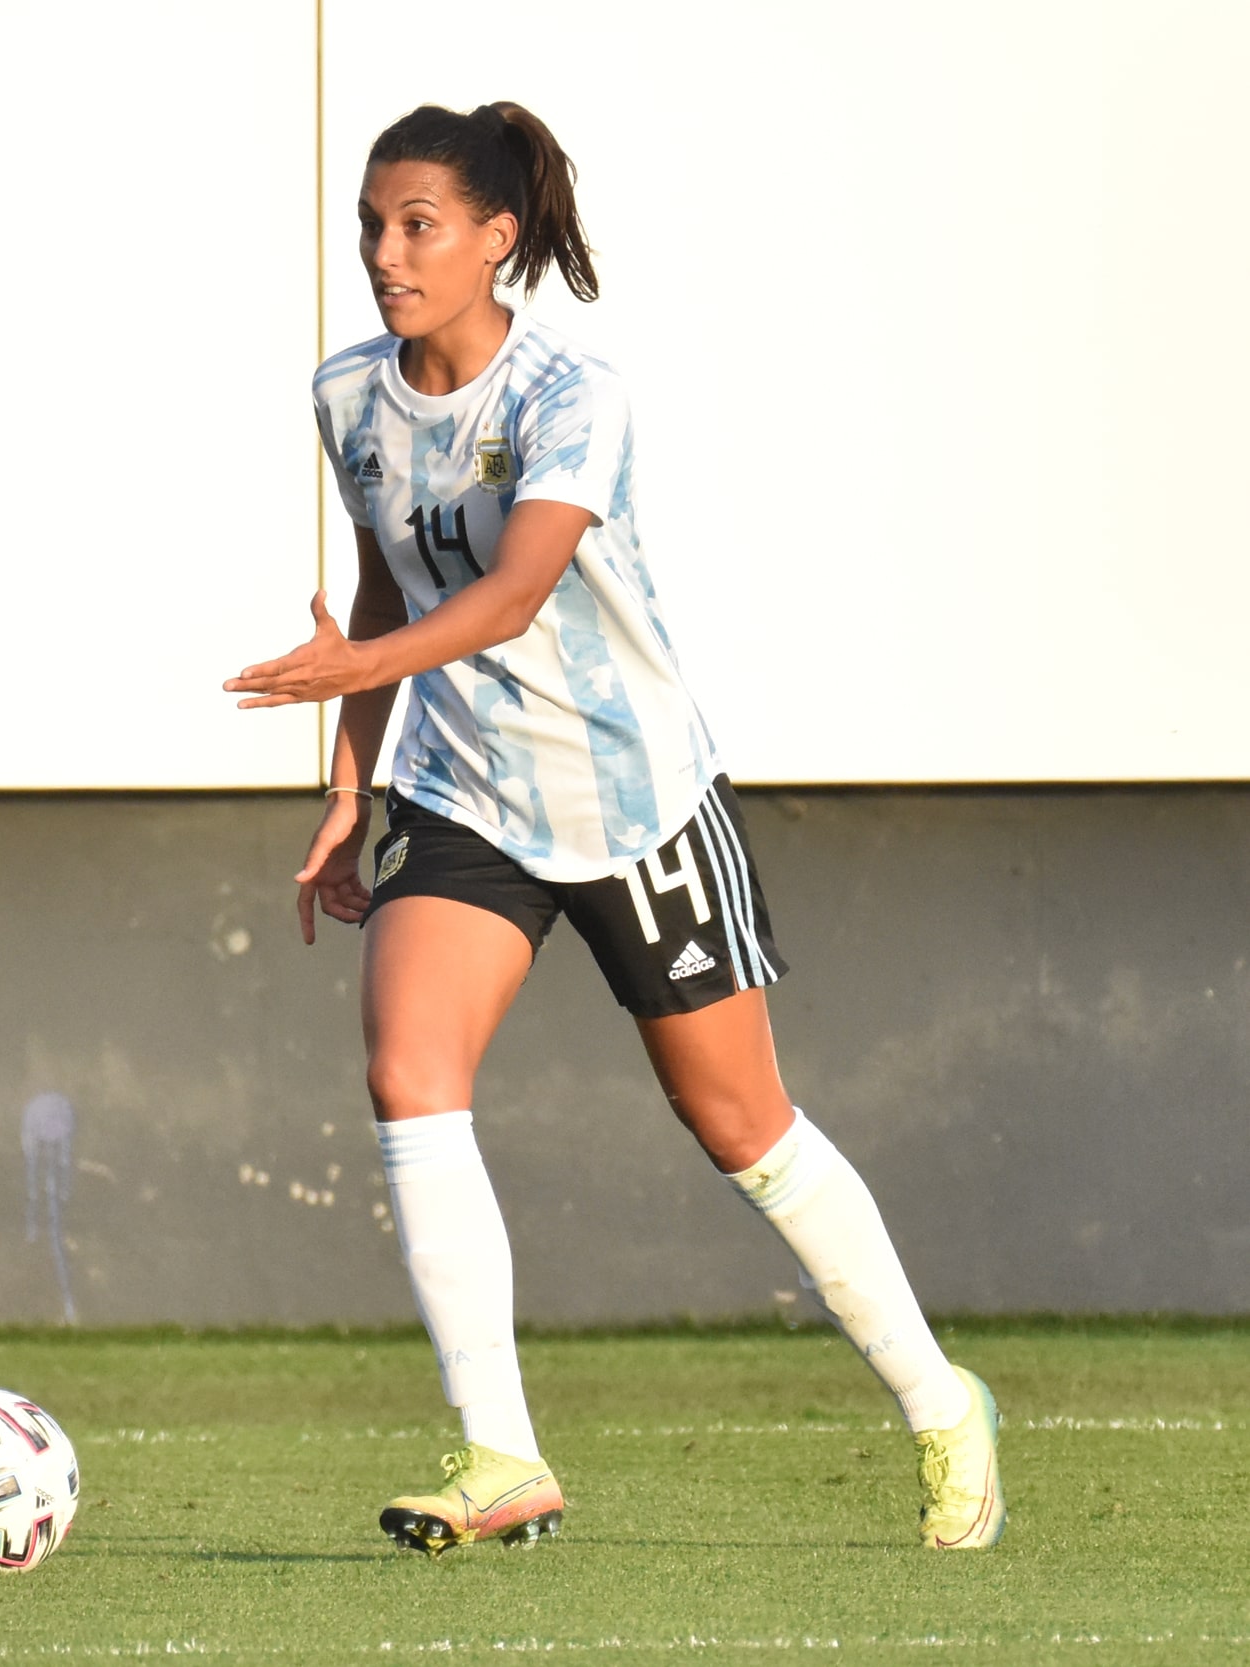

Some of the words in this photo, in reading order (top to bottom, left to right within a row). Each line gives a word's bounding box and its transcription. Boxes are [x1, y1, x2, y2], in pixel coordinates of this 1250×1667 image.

[484, 453, 507, 478] AFA
[404, 504, 485, 589] 14
[614, 832, 711, 944] 14
[668, 957, 716, 980] adidas
